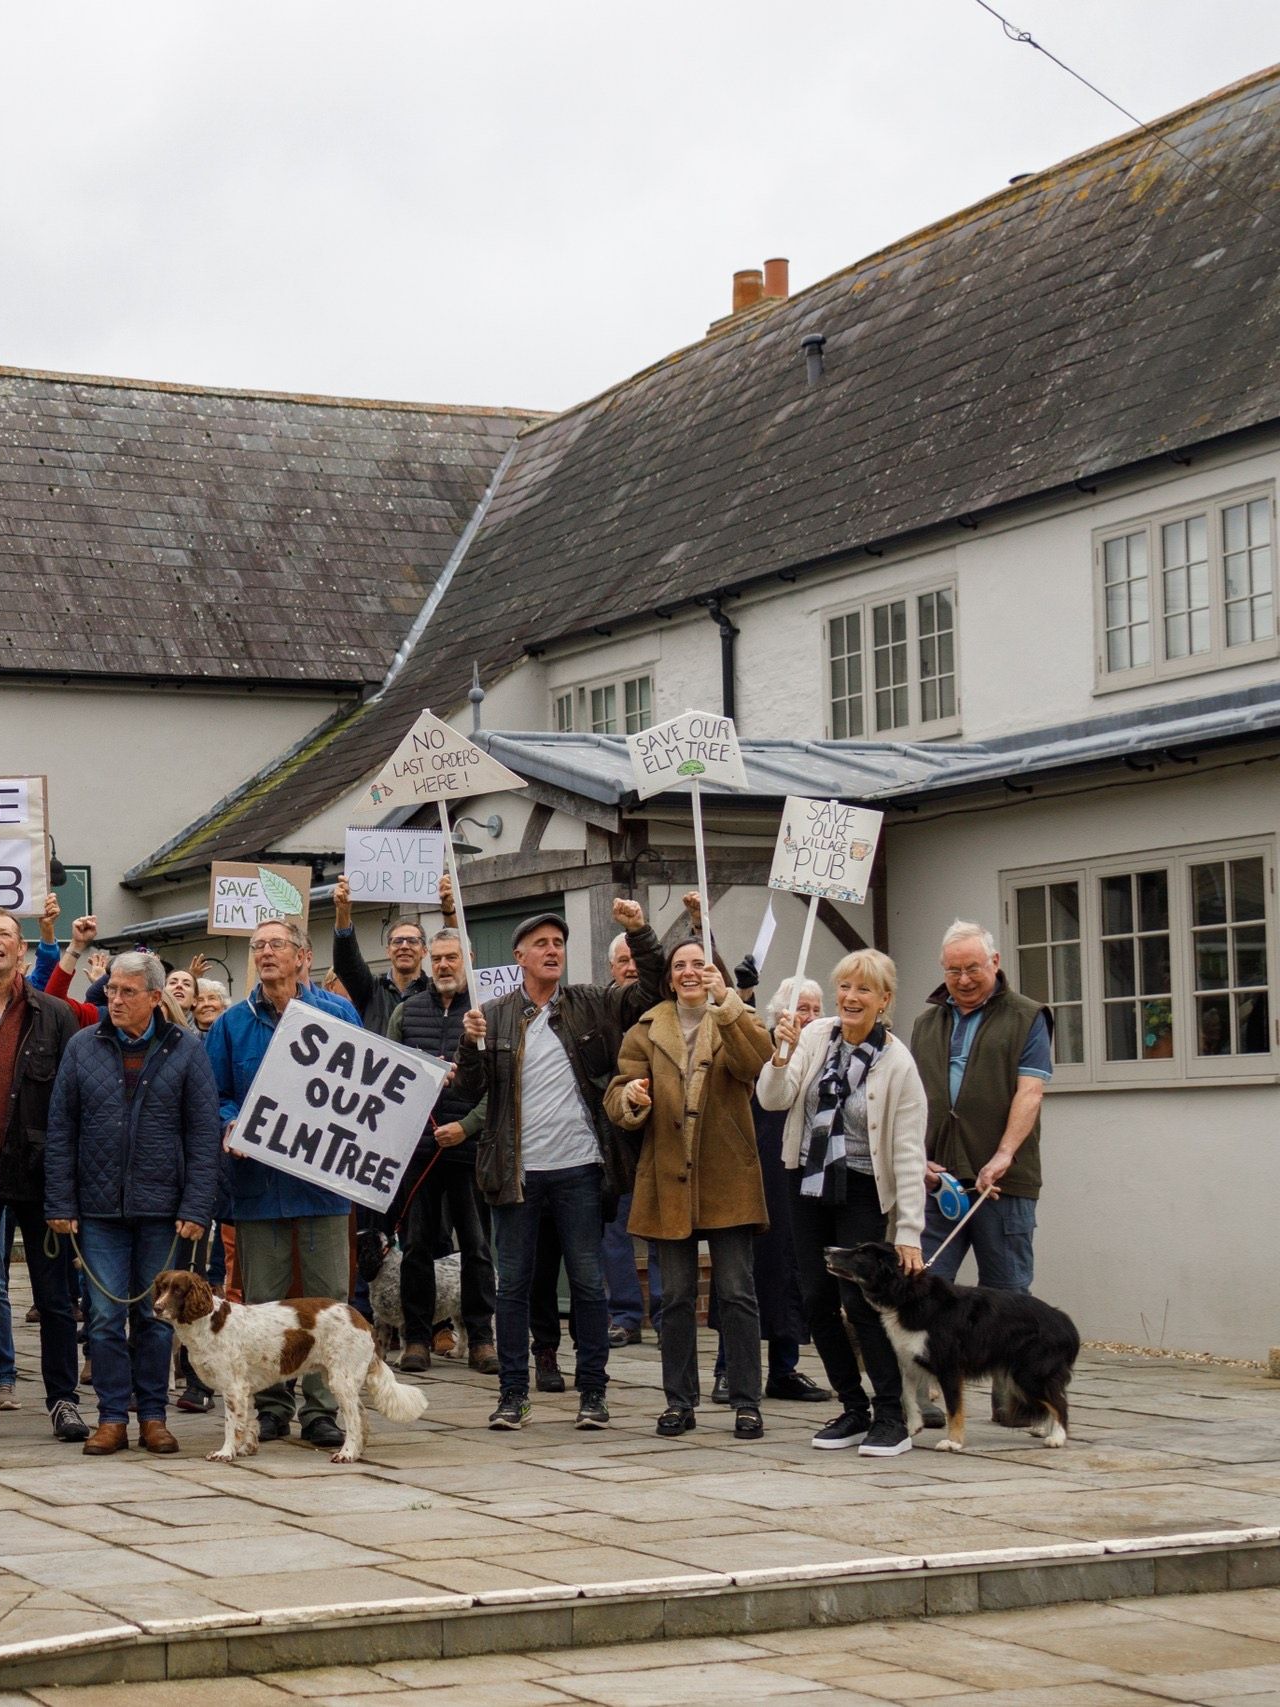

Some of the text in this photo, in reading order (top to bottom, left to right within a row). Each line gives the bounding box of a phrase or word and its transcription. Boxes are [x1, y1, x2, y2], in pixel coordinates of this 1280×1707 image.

[412, 729, 445, 753] NO
[636, 718, 730, 756] SAVE OUR
[393, 747, 480, 778] LAST ORDERS
[642, 741, 730, 775] ELM TREE
[806, 800, 857, 828] SAVE
[802, 835, 848, 854] VILLAGE
[811, 820, 847, 842] OUR
[359, 835, 436, 864] SAVE
[793, 847, 846, 881] PUB
[217, 879, 259, 897] SAVE
[348, 870, 438, 895] OUR PUB
[215, 904, 247, 923] ELM
[480, 966, 520, 986] SAV
[289, 1023, 417, 1105] SAVE
[305, 1077, 386, 1132] OUR
